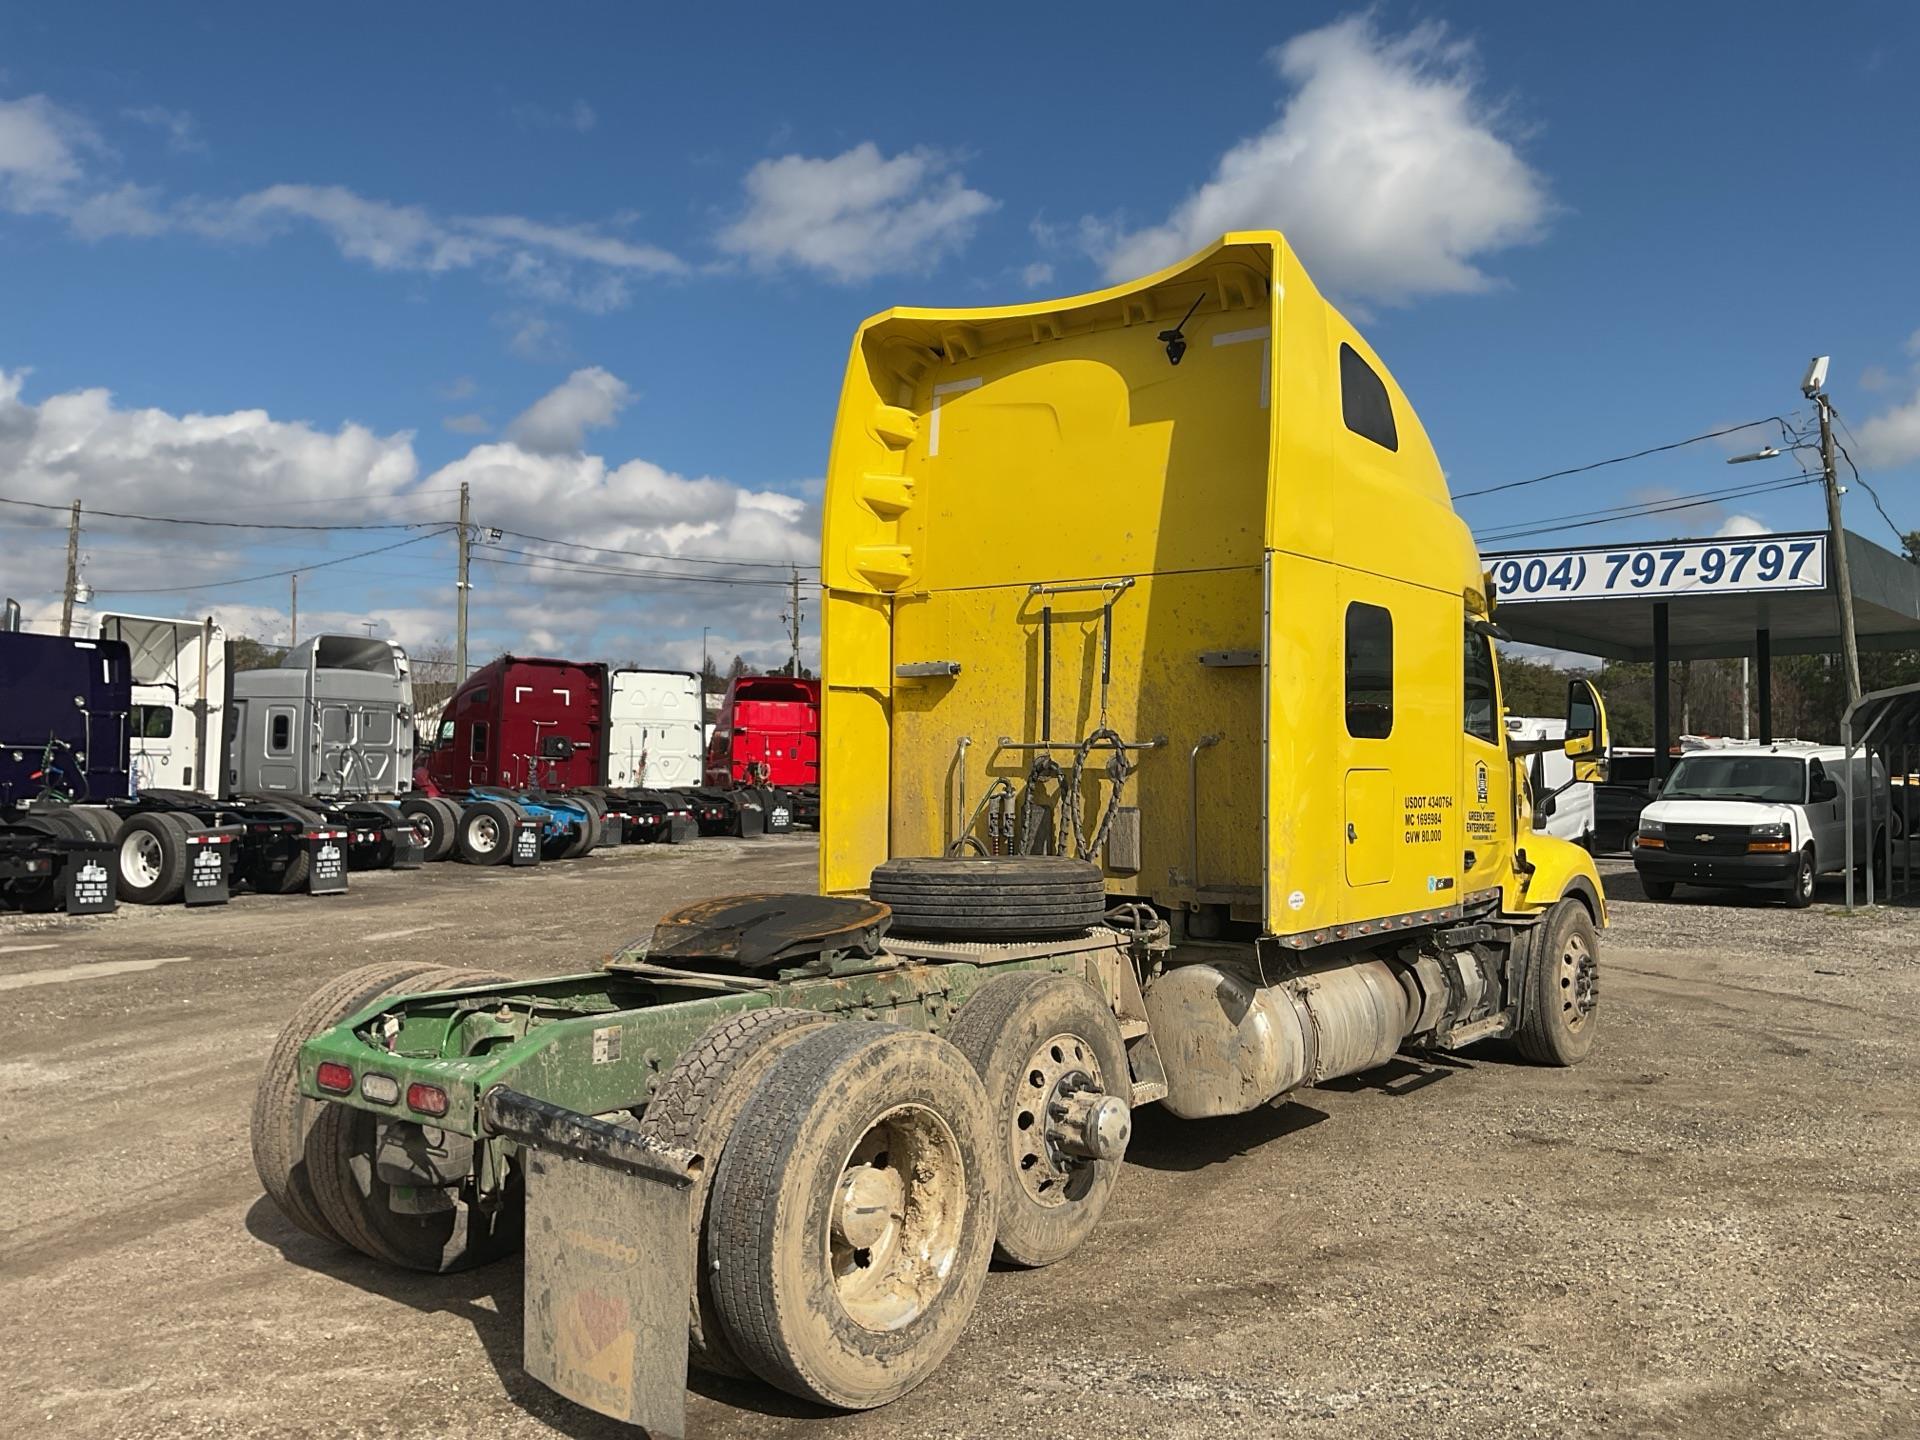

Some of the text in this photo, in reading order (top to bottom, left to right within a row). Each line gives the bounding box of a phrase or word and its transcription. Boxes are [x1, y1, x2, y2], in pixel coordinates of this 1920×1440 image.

[1605, 543, 1816, 589] 797-9797
[1404, 796, 1426, 809] USDOT
[1404, 813, 1414, 826] MC
[1405, 830, 1420, 843] GVW
